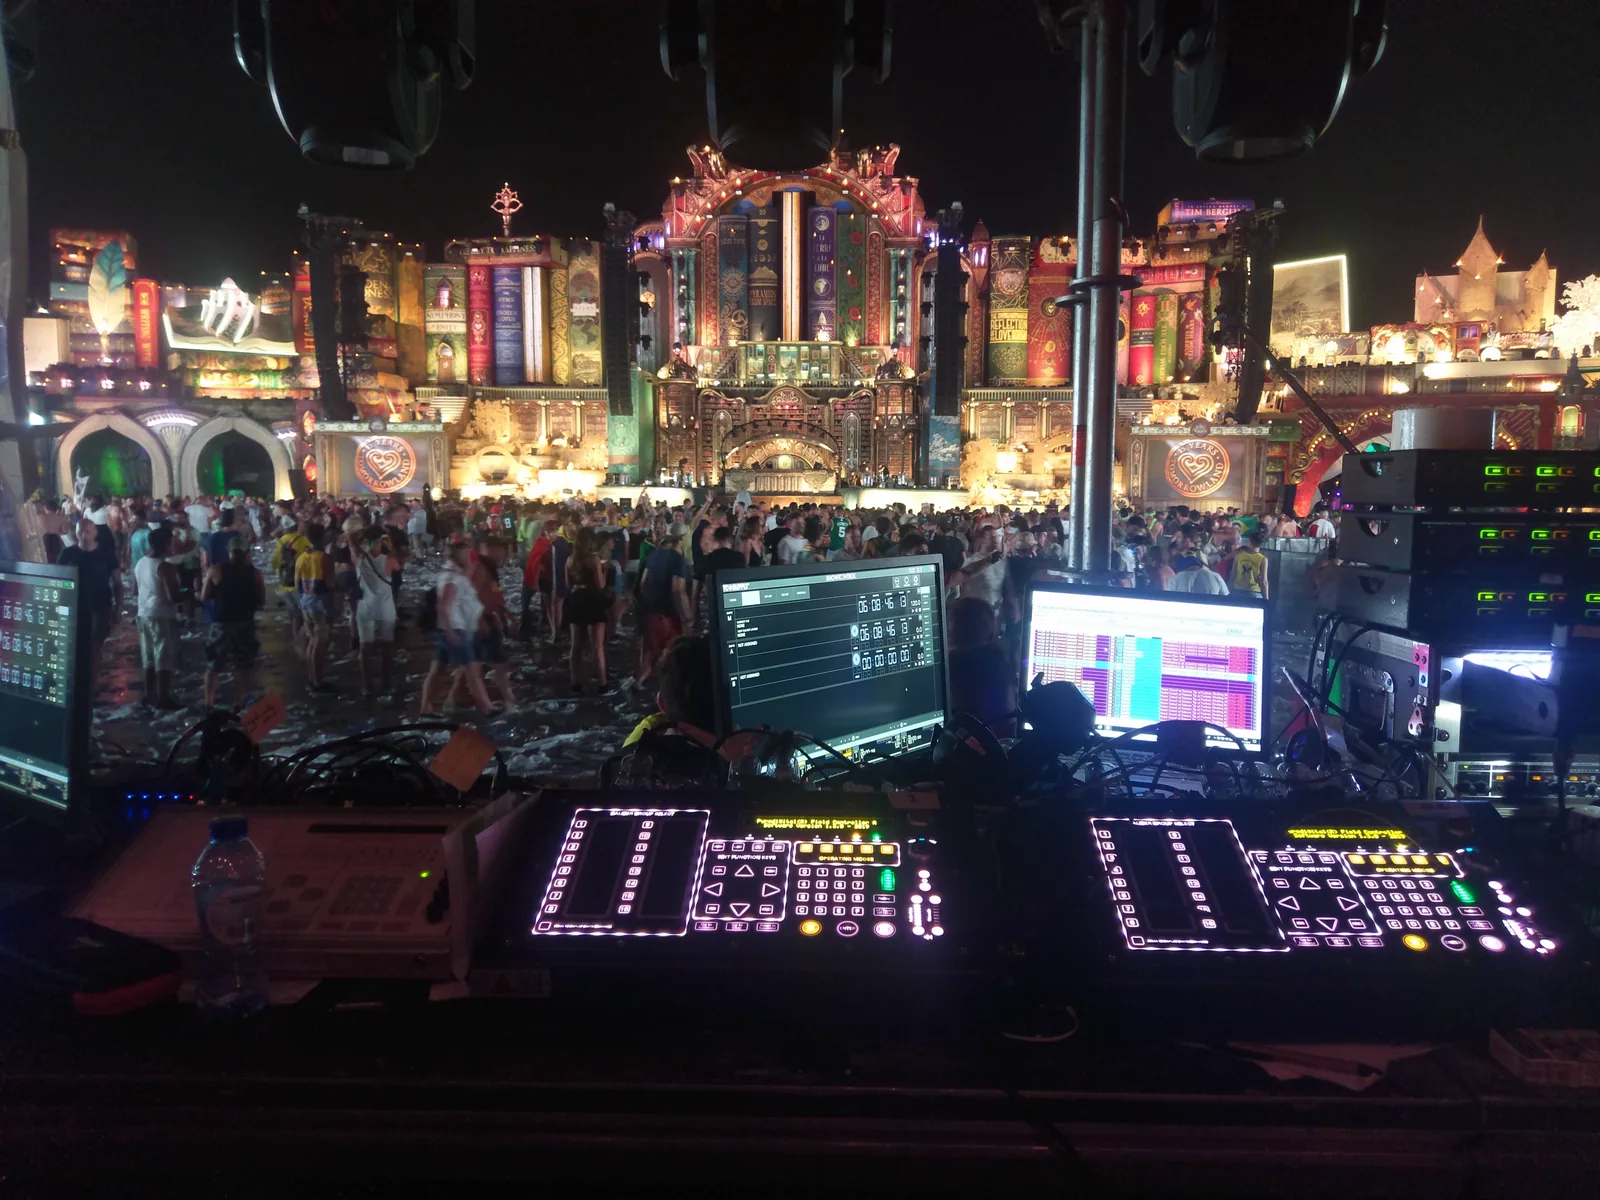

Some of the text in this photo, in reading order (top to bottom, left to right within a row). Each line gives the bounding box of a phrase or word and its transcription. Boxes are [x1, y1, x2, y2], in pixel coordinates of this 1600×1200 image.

[375, 439, 404, 452] YEARS
[1189, 442, 1218, 456] YEARS
[359, 456, 410, 488] TOMORROWLAND
[839, 526, 846, 537] 5
